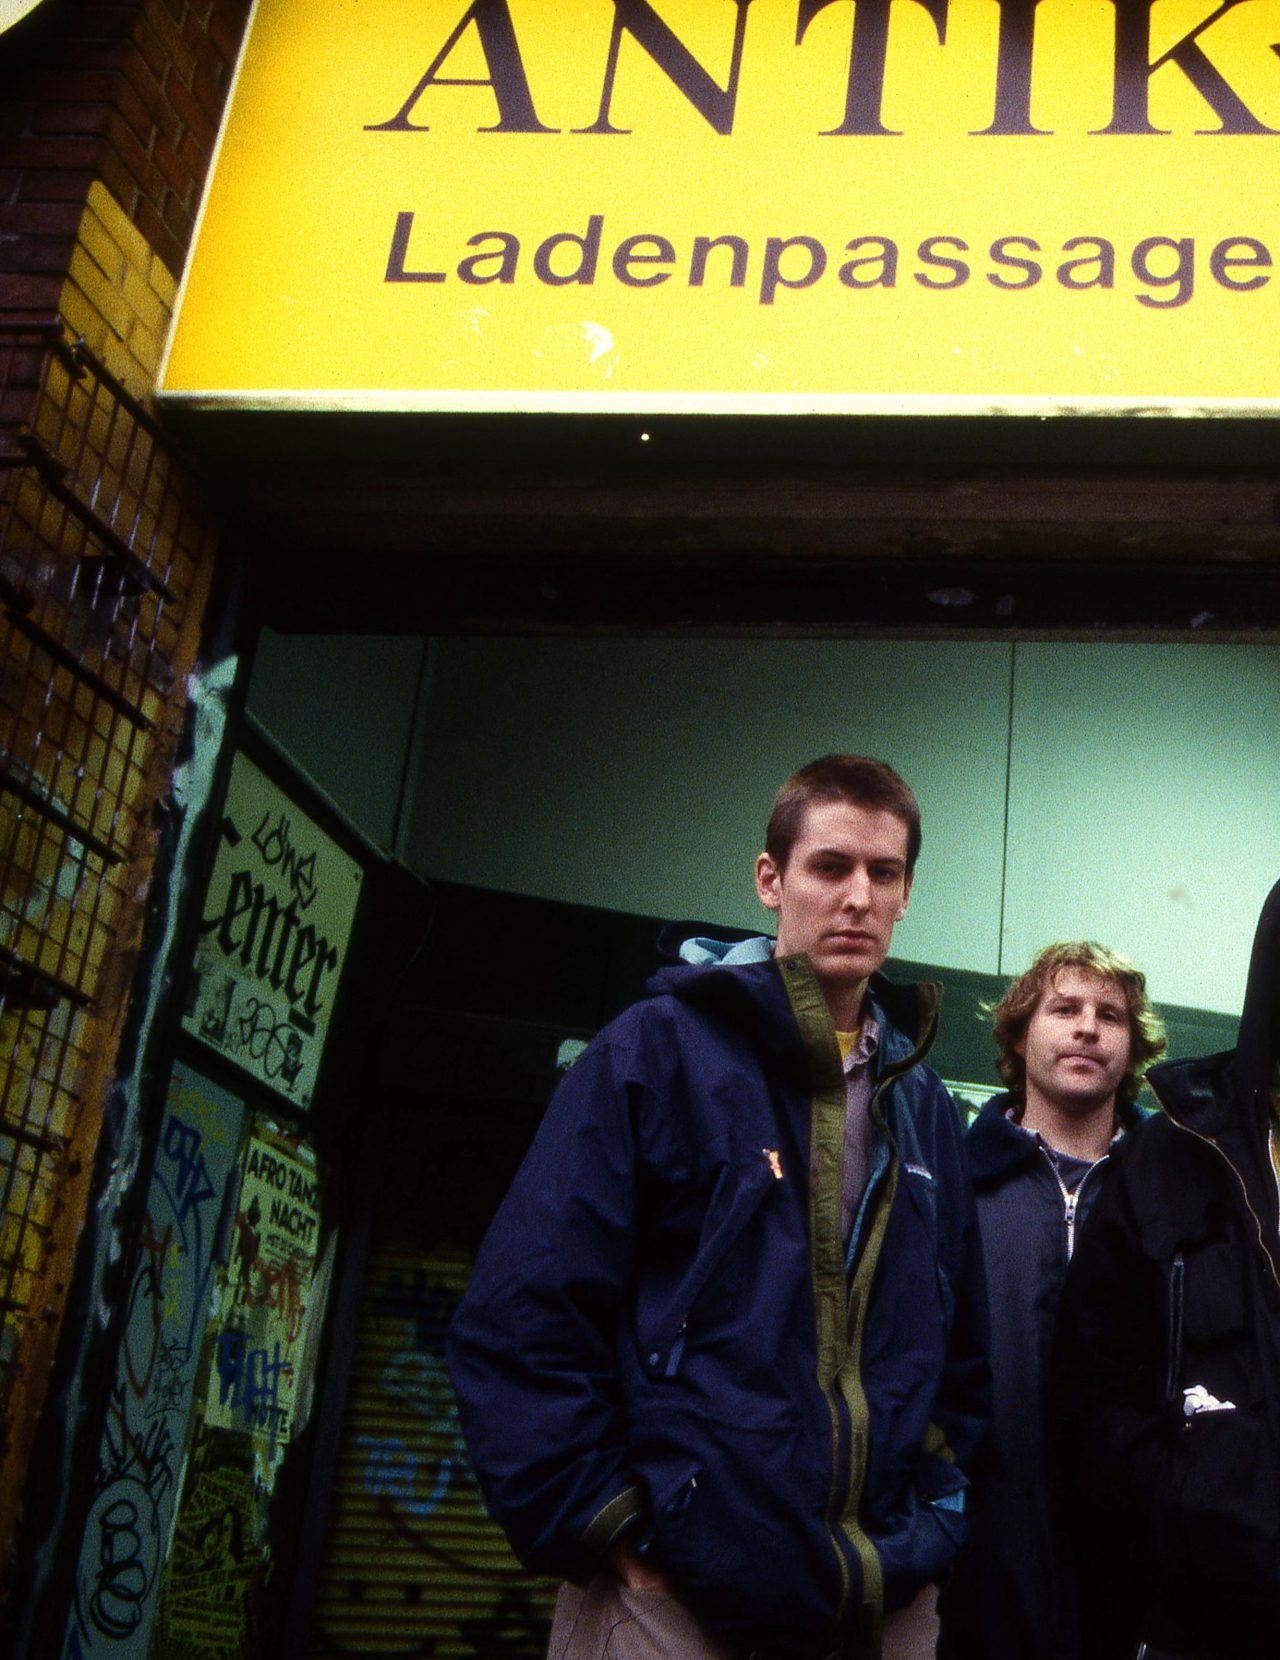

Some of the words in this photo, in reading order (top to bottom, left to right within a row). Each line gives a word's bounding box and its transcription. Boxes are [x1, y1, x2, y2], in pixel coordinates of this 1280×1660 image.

[384, 211, 1273, 307] Ladenpassage
[248, 1149, 287, 1191] AFRO
[269, 1198, 316, 1243] NACHT
